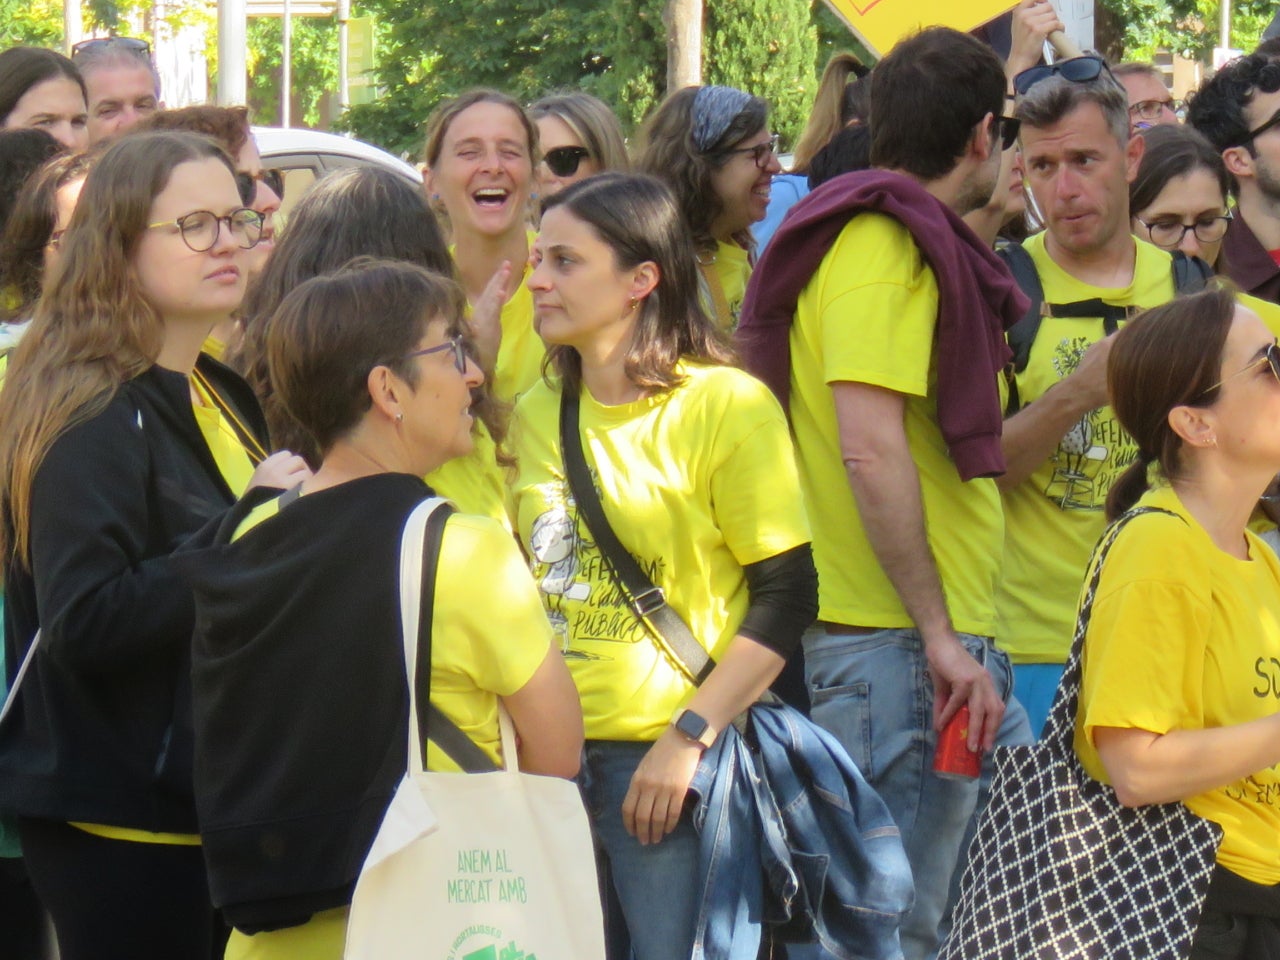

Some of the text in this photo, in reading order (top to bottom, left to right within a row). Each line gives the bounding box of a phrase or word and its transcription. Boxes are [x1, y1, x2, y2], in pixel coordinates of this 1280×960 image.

[457, 849, 512, 873] ANEM AL
[447, 877, 528, 904] MERCAT AMB
